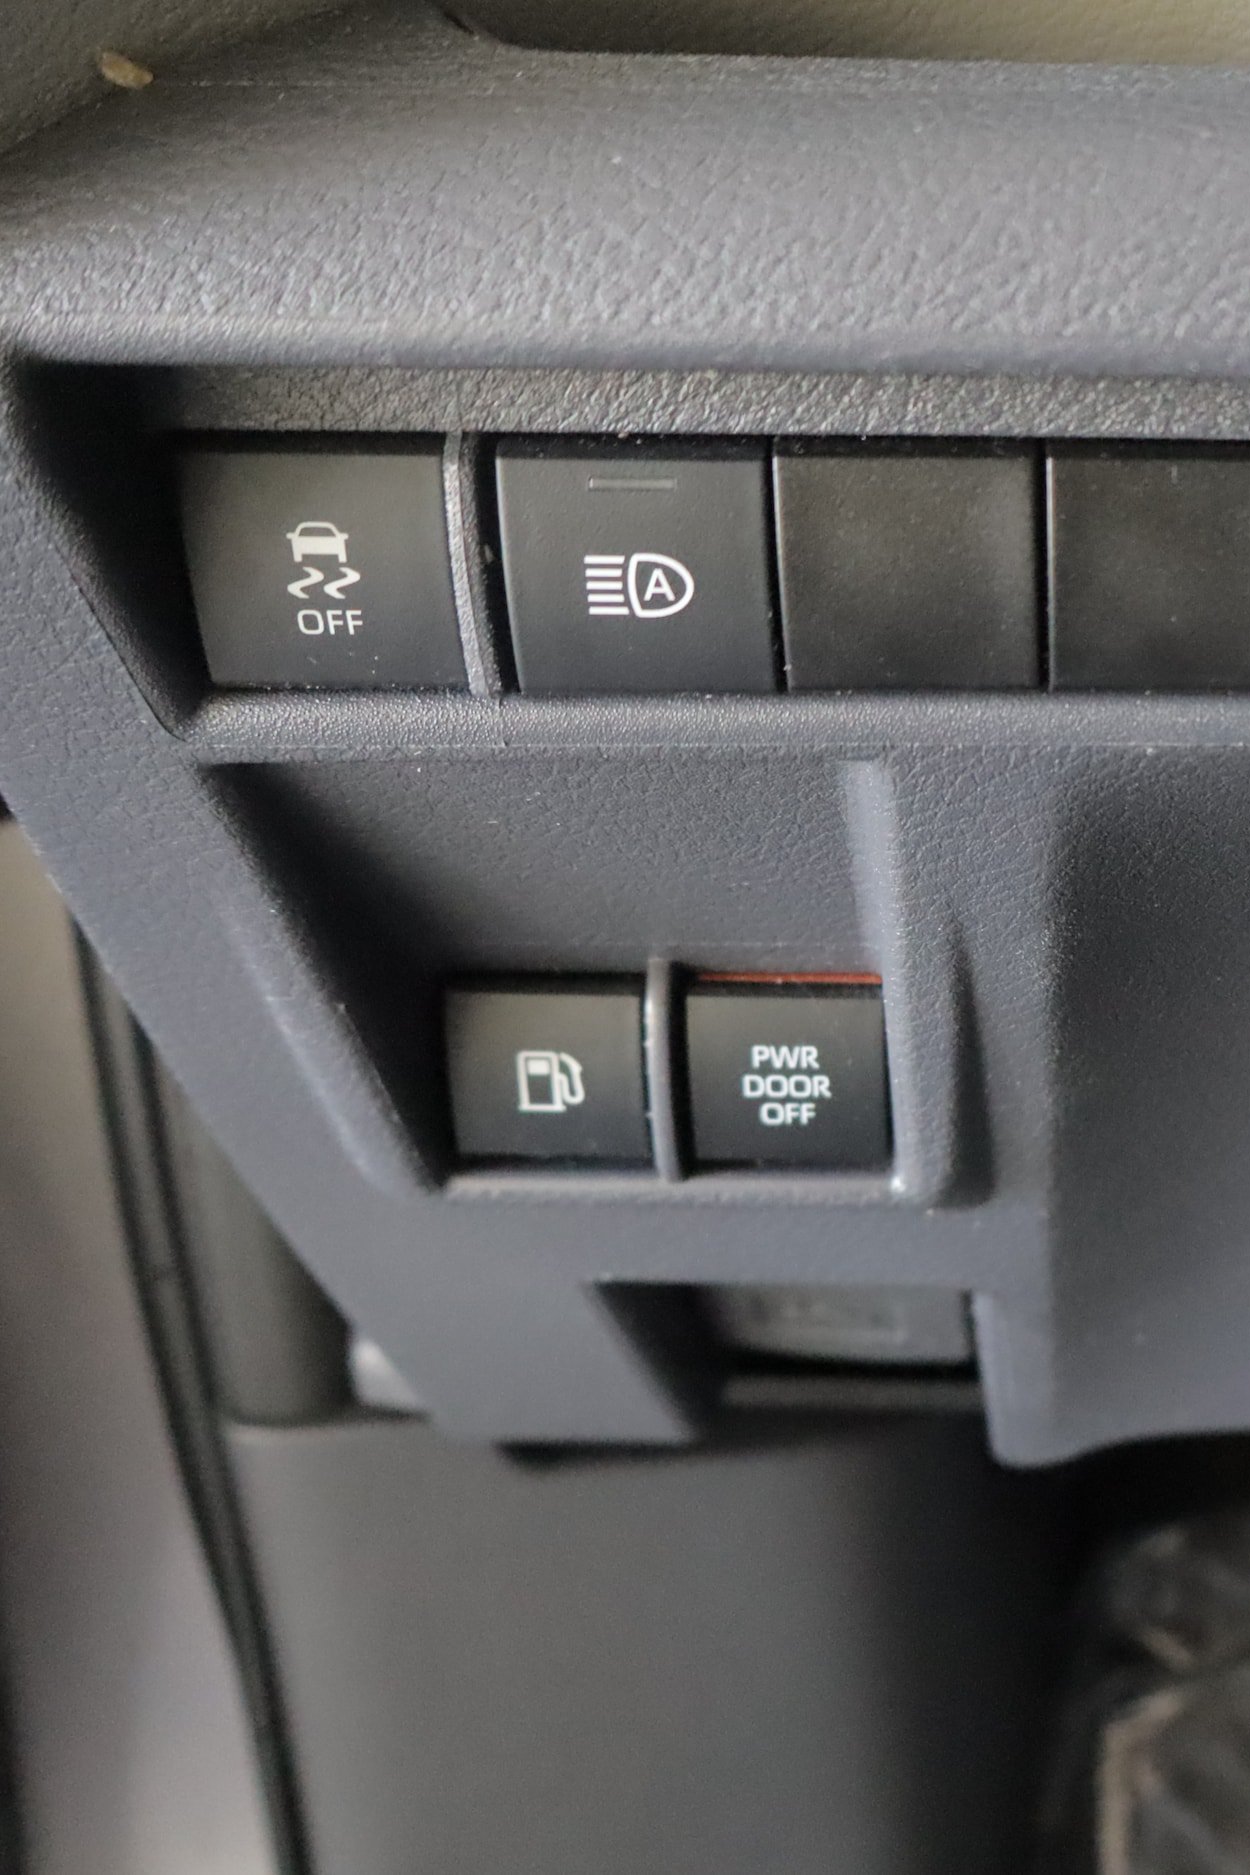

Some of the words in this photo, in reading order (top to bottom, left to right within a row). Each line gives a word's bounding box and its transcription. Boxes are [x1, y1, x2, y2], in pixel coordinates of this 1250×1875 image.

[643, 567, 676, 602] A
[296, 608, 364, 636] OFF
[751, 1045, 820, 1069] PWR
[742, 1074, 832, 1099] DOOR
[759, 1102, 816, 1126] OFF
